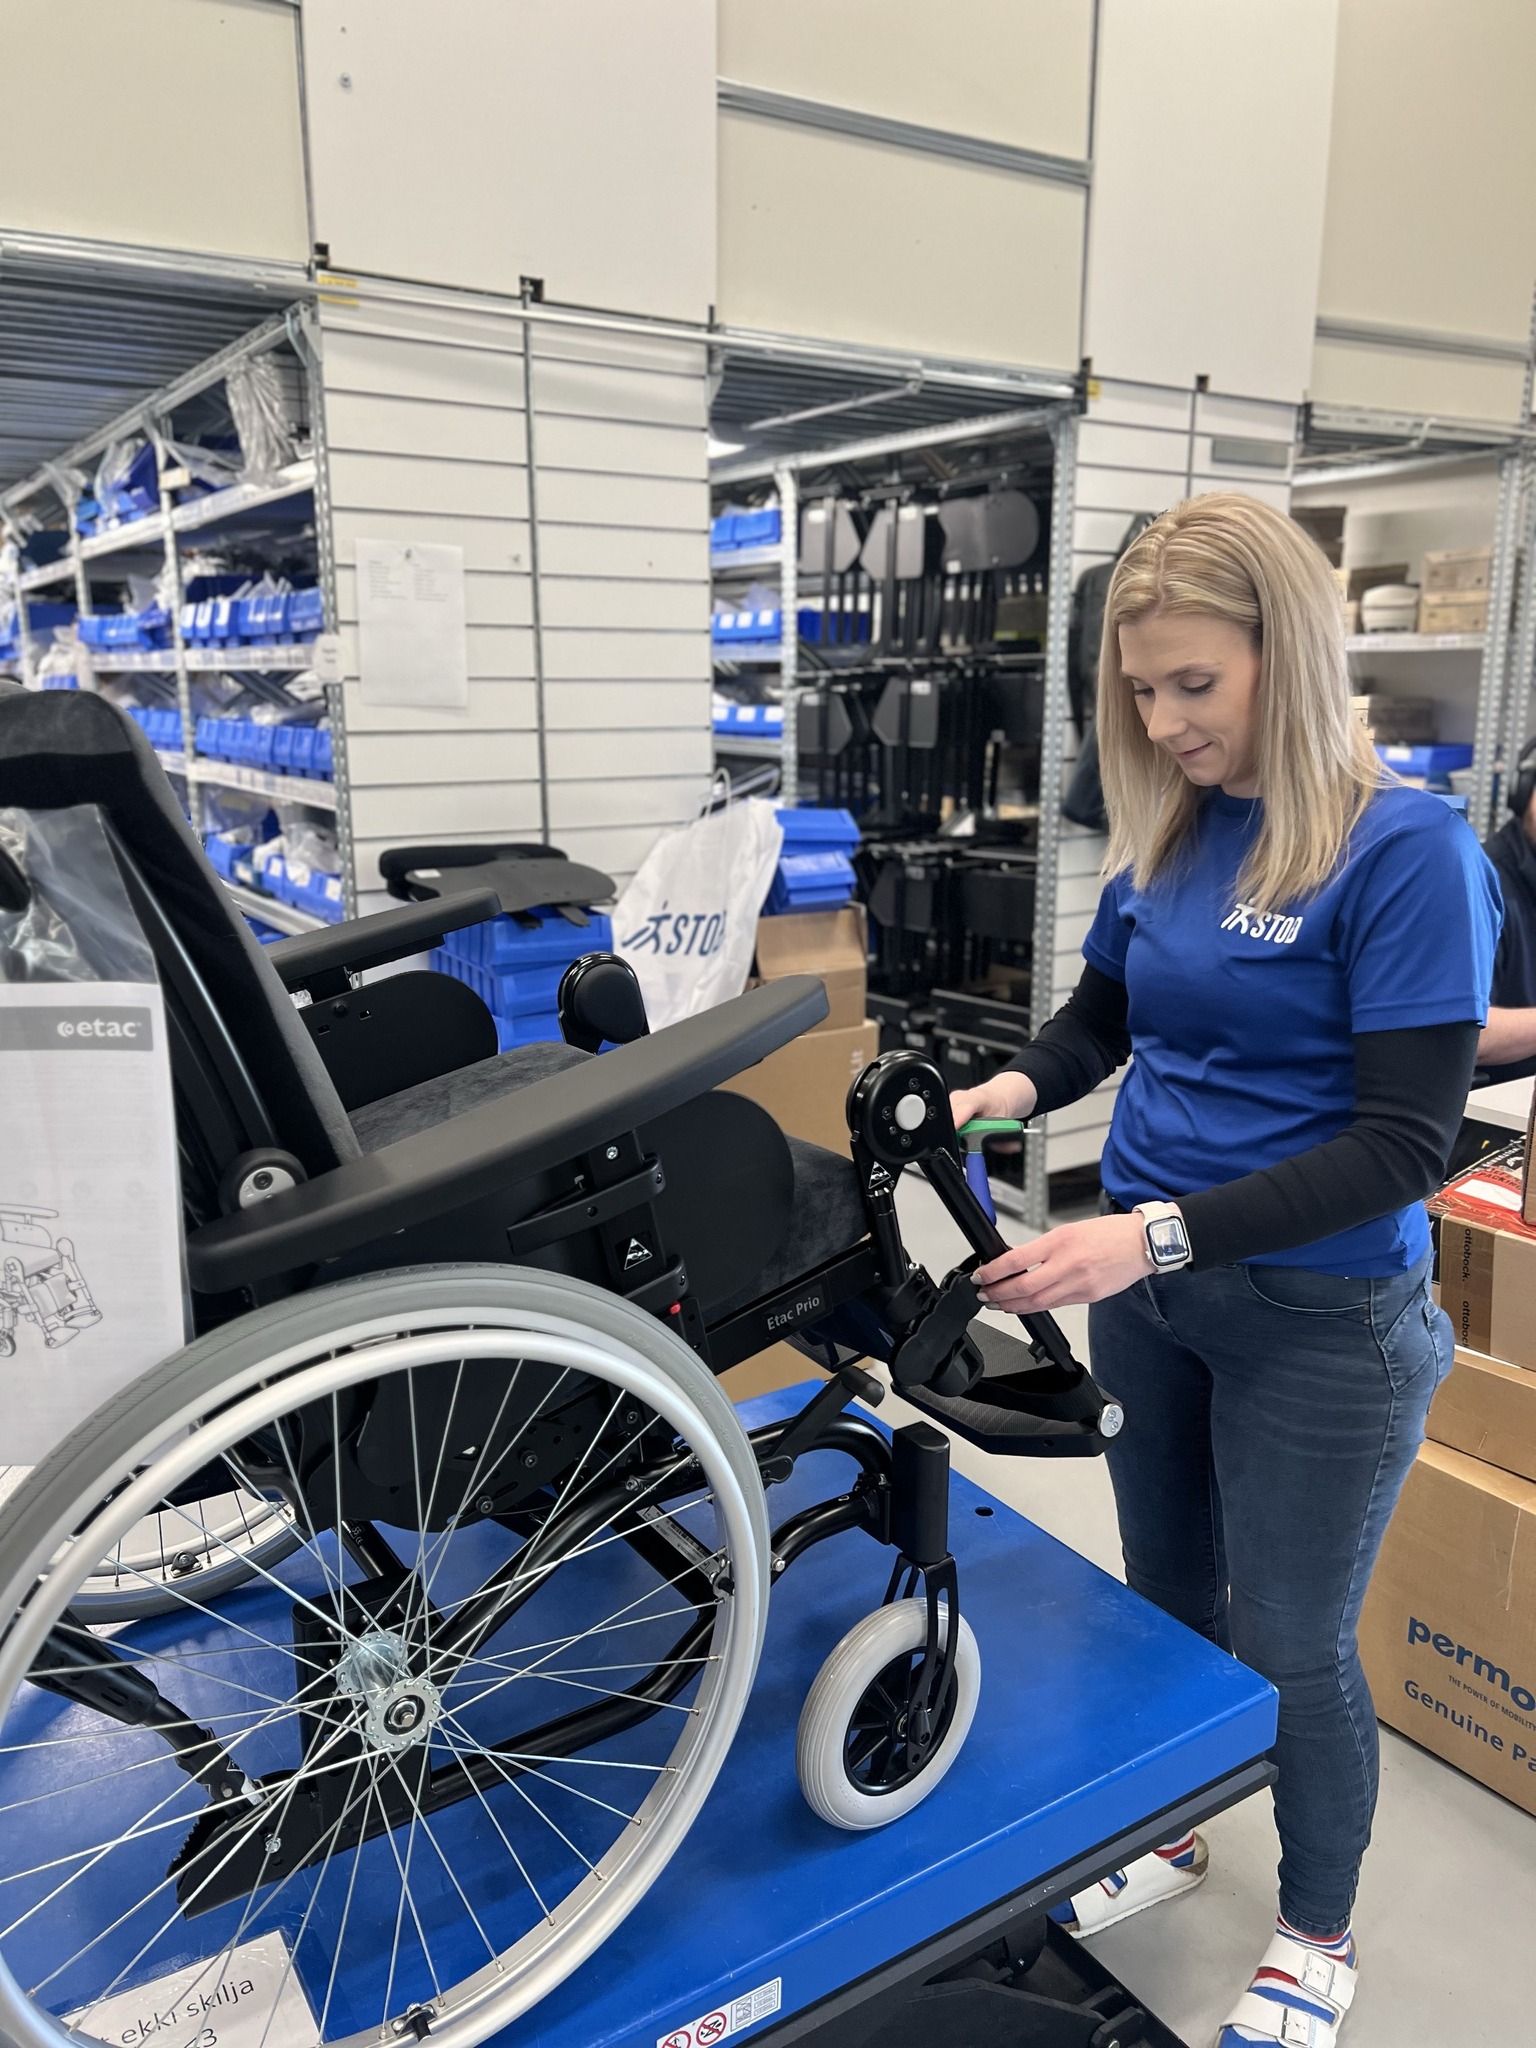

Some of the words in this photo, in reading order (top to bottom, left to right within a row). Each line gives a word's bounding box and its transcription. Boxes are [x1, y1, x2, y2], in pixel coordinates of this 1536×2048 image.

[76, 1018, 137, 1038] etac
[767, 1310, 794, 1331] Etac
[795, 1297, 820, 1316] Prio
[1448, 1675, 1461, 1688] THE
[1462, 1683, 1489, 1704] POWER
[1489, 1699, 1501, 1710] OF
[1404, 1680, 1504, 1753] Genuine
[186, 1980, 255, 2018] skilja
